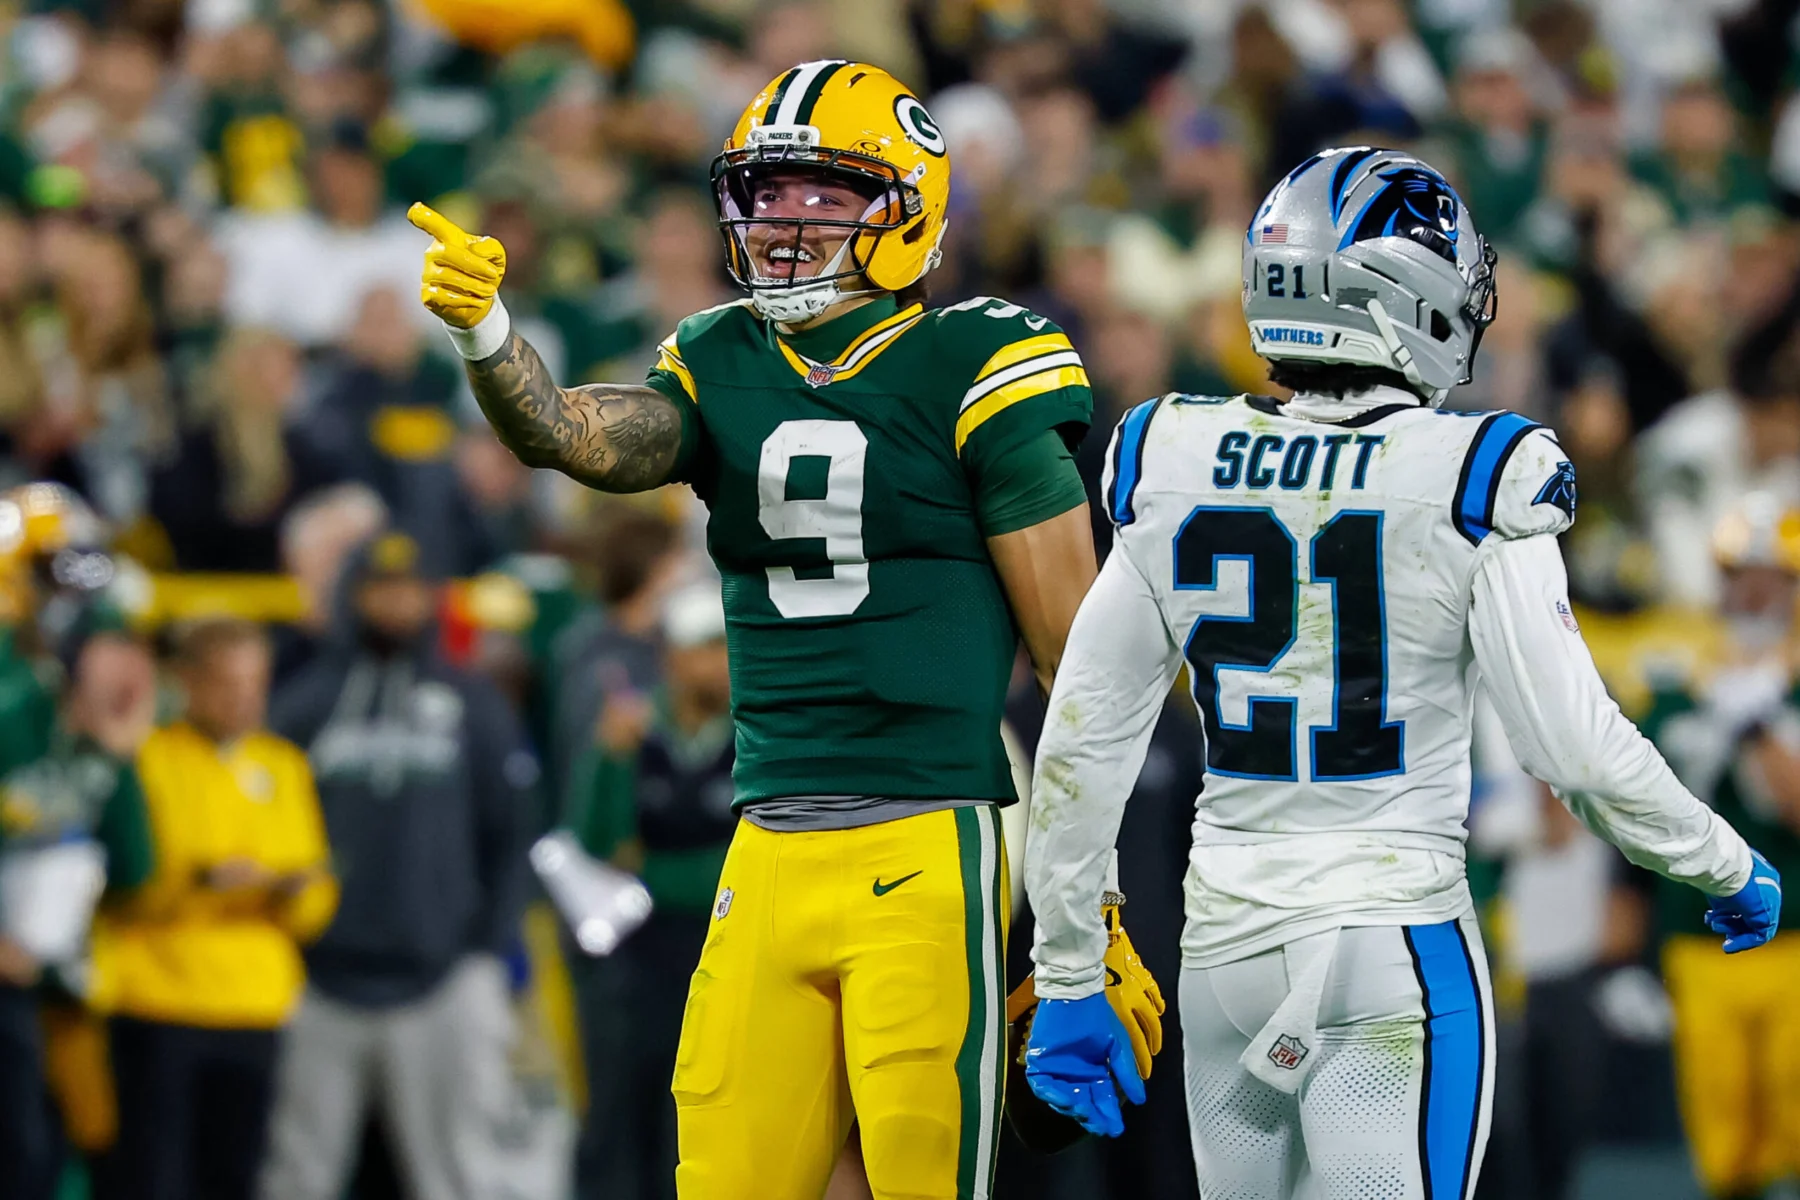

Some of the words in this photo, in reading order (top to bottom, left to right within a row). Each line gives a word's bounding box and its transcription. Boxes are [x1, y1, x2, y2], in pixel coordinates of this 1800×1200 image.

[768, 132, 793, 140] PACKERS
[893, 94, 947, 158] G
[1267, 263, 1307, 299] 21
[1263, 328, 1324, 345] PANTHERS
[1213, 430, 1386, 490] SCOTT
[758, 419, 870, 619] 9
[1173, 505, 1406, 782] 21
